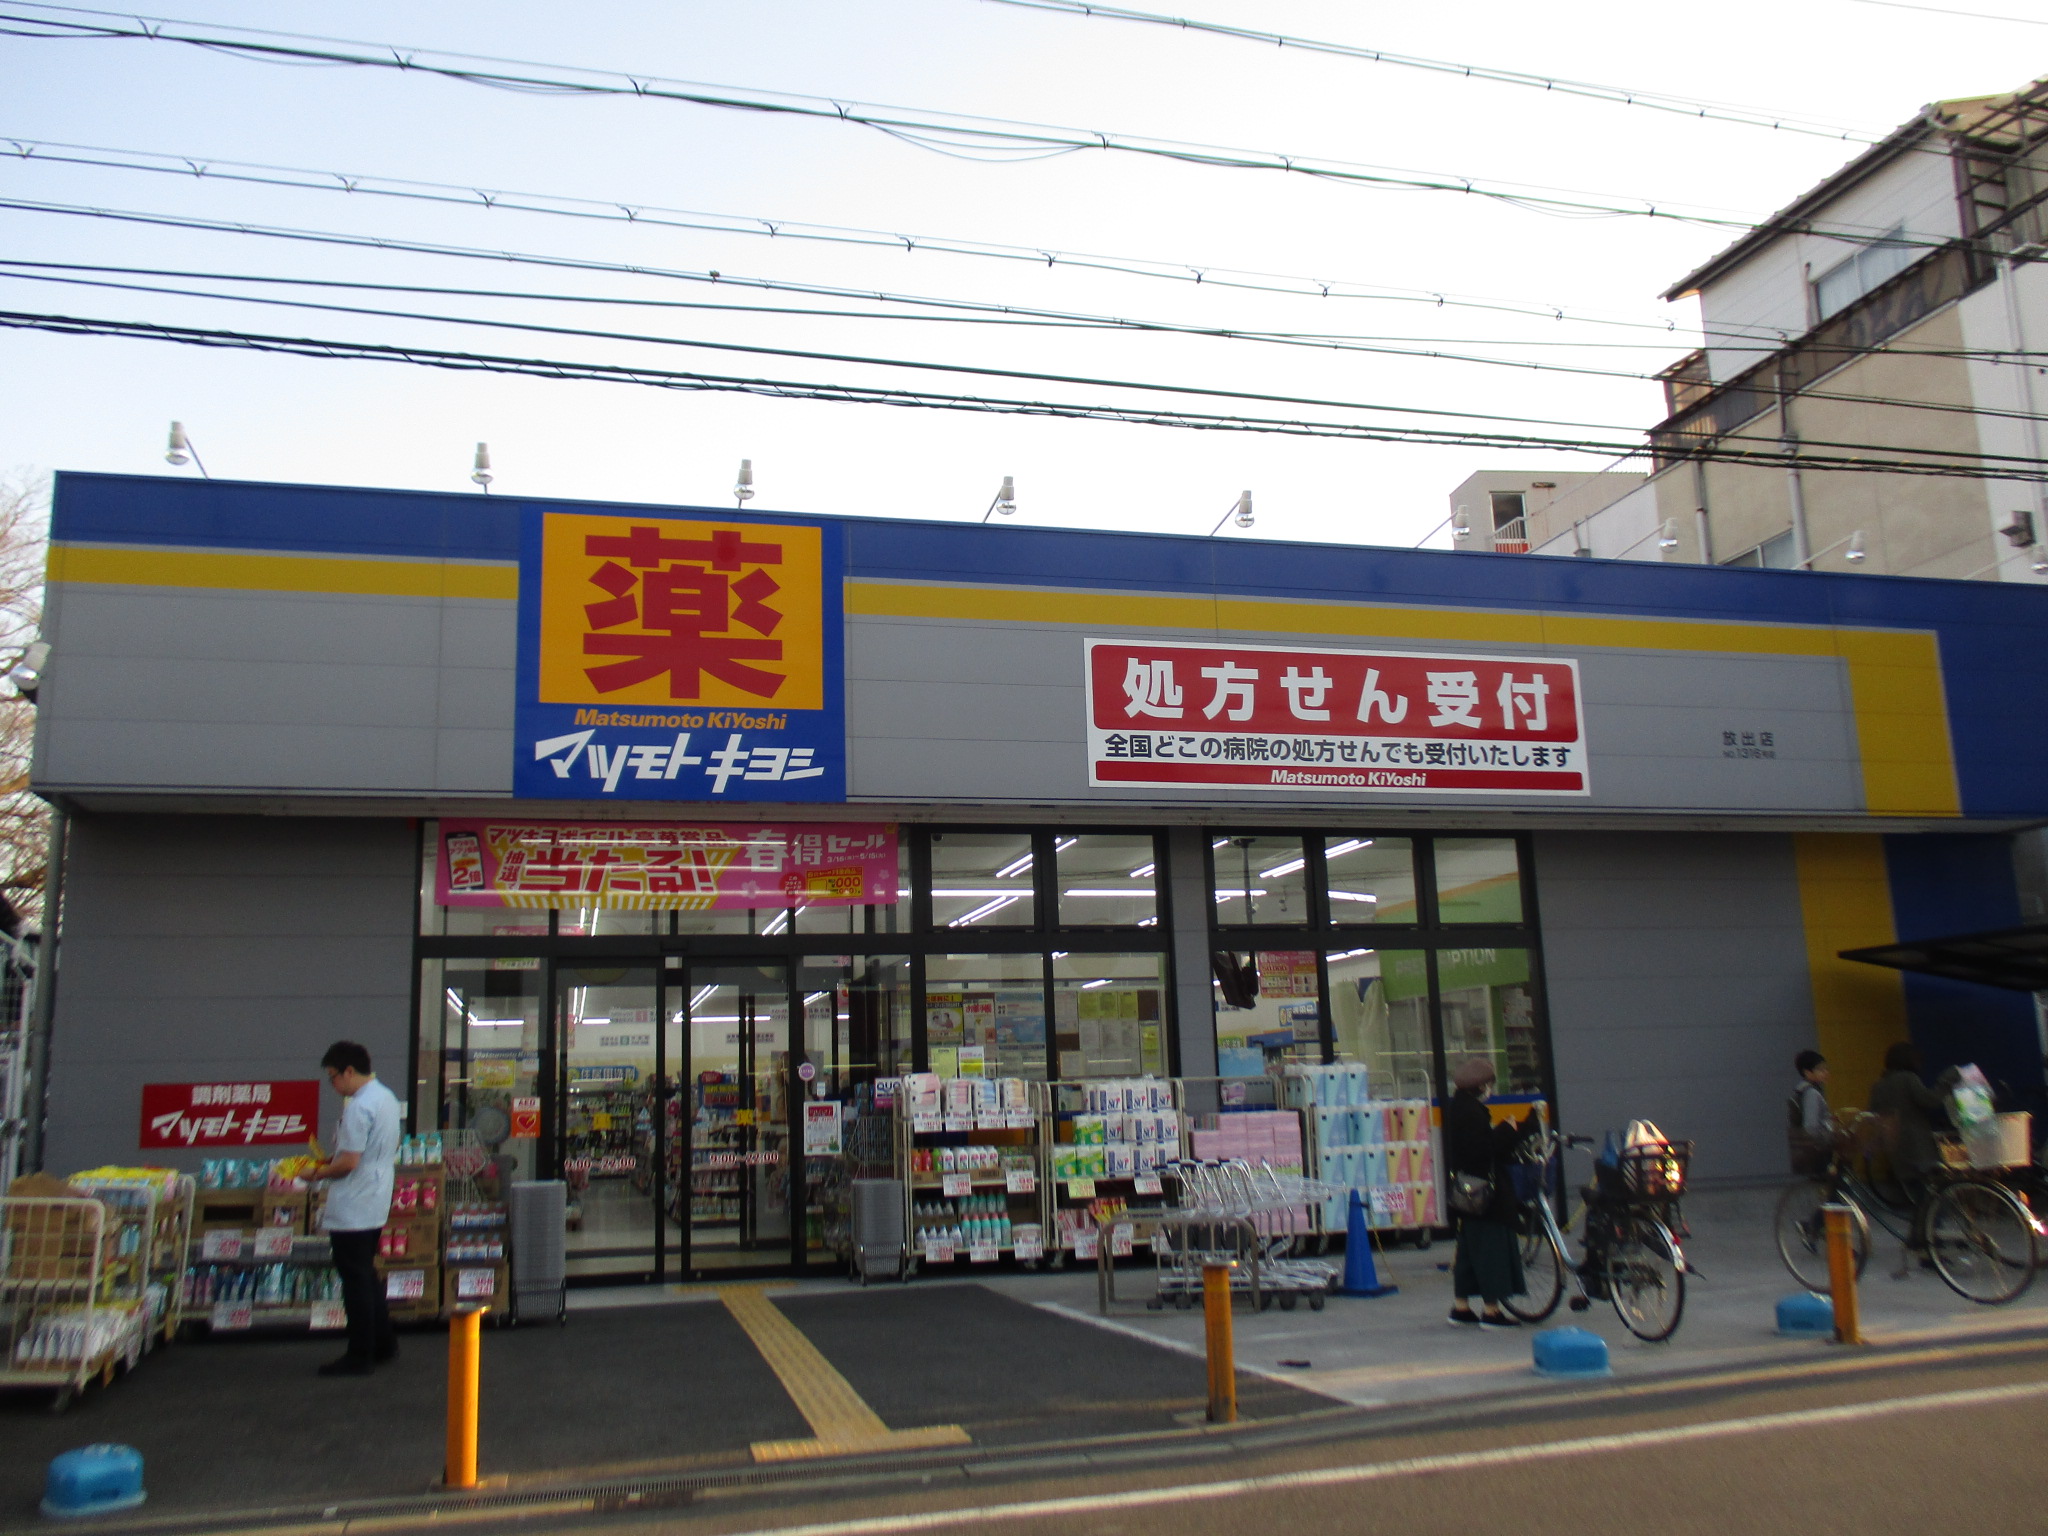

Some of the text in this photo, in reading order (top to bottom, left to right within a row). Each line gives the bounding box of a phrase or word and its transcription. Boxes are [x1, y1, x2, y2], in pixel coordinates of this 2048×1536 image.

[583, 526, 787, 699] 薬
[1122, 657, 1549, 731] 処方せん受付
[574, 709, 787, 730] Matsumoto KiYoshi
[535, 729, 825, 793] マツモトキヨシ
[1105, 733, 1571, 768] 全国どこの病院の処方せんでも受付いたします
[1271, 769, 1426, 787] Matsumoto KiYoshi
[152, 1109, 307, 1145] マツモトキヨシ
